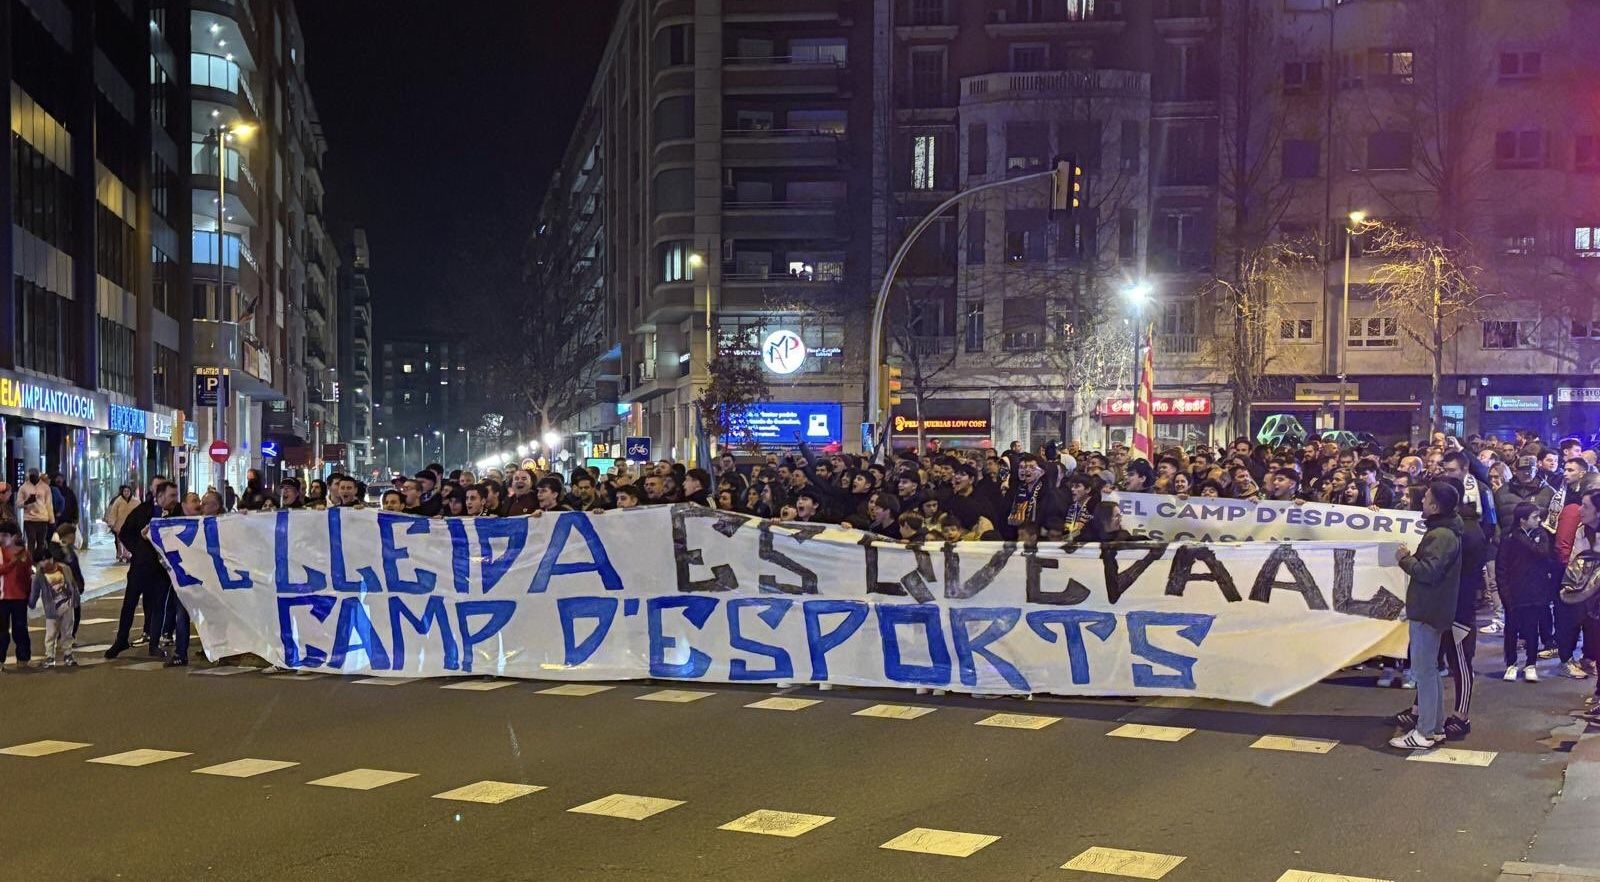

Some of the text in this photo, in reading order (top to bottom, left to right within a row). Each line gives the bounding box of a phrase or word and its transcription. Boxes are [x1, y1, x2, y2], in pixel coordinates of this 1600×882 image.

[207, 377, 218, 390] P
[952, 420, 968, 428] LOW
[968, 420, 987, 428] COST
[1119, 500, 1147, 516] EL
[1157, 502, 1244, 522] CAMP
[1257, 507, 1427, 536] D'ESPORTS
[150, 517, 253, 589] EL
[275, 508, 624, 594] LLEIDA
[671, 502, 826, 595] ES
[277, 595, 1216, 692] CAMP D'ESPORTS
